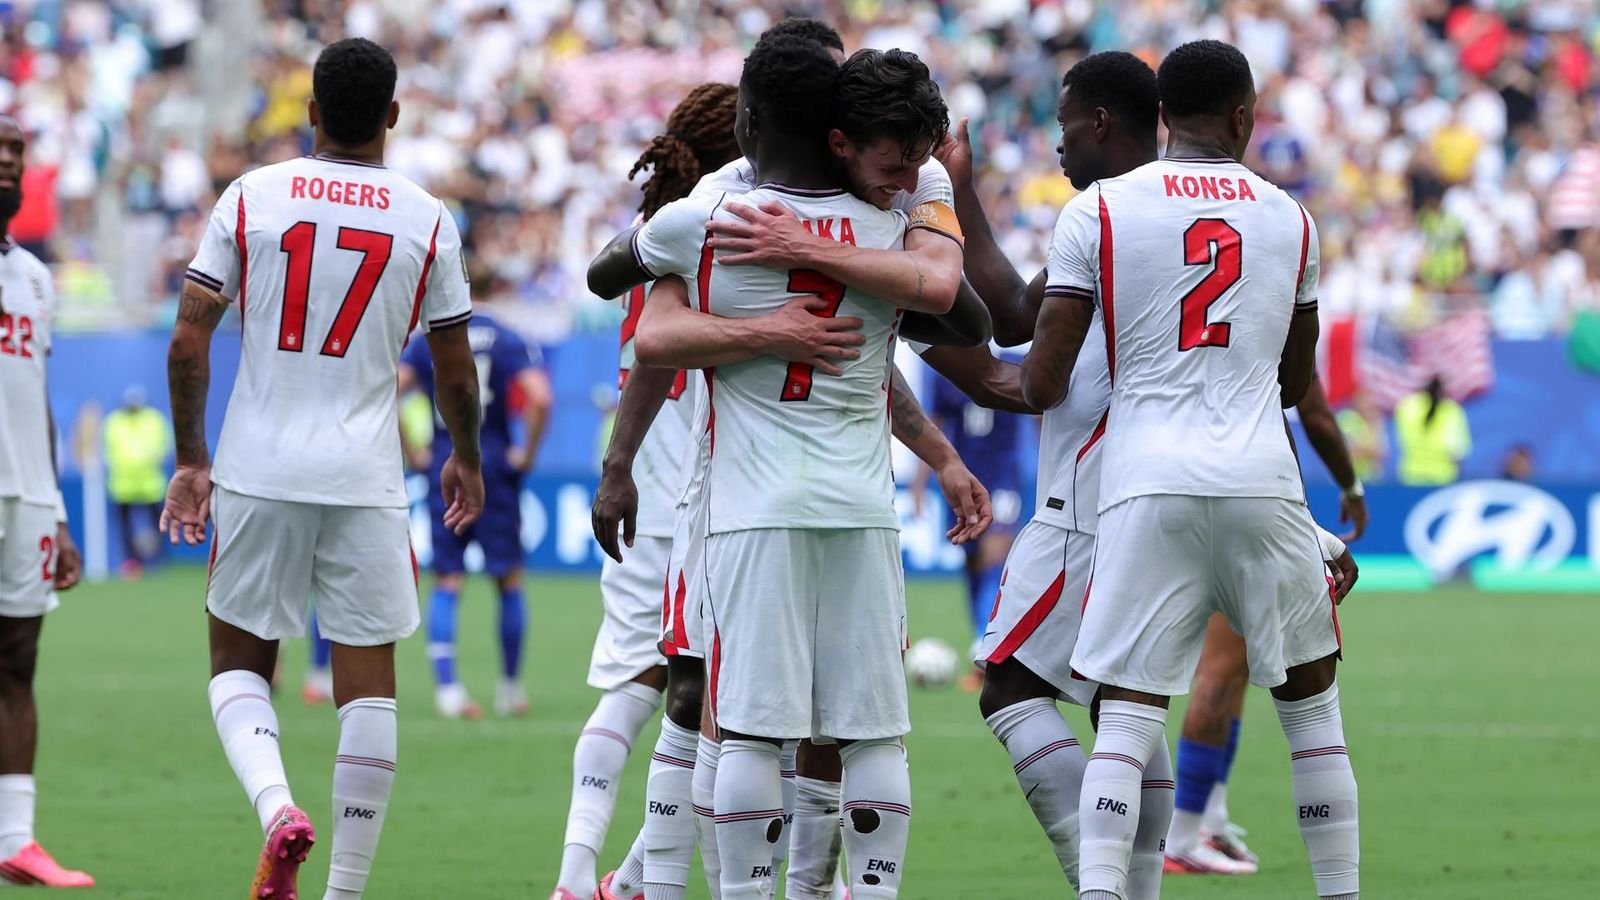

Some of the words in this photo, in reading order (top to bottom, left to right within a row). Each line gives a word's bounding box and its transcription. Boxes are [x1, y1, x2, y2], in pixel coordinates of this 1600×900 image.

[291, 176, 391, 210] ROGERS
[1163, 175, 1256, 202] KONSA
[278, 221, 393, 358] 17
[1178, 218, 1242, 352] 2
[0, 313, 34, 359] 22
[779, 270, 846, 402] 7
[582, 776, 609, 790] ENG
[343, 806, 376, 820] ENG
[649, 801, 679, 817] ENG
[1096, 797, 1128, 818] ENG
[1299, 804, 1331, 819] ENG
[867, 859, 898, 874] ENG
